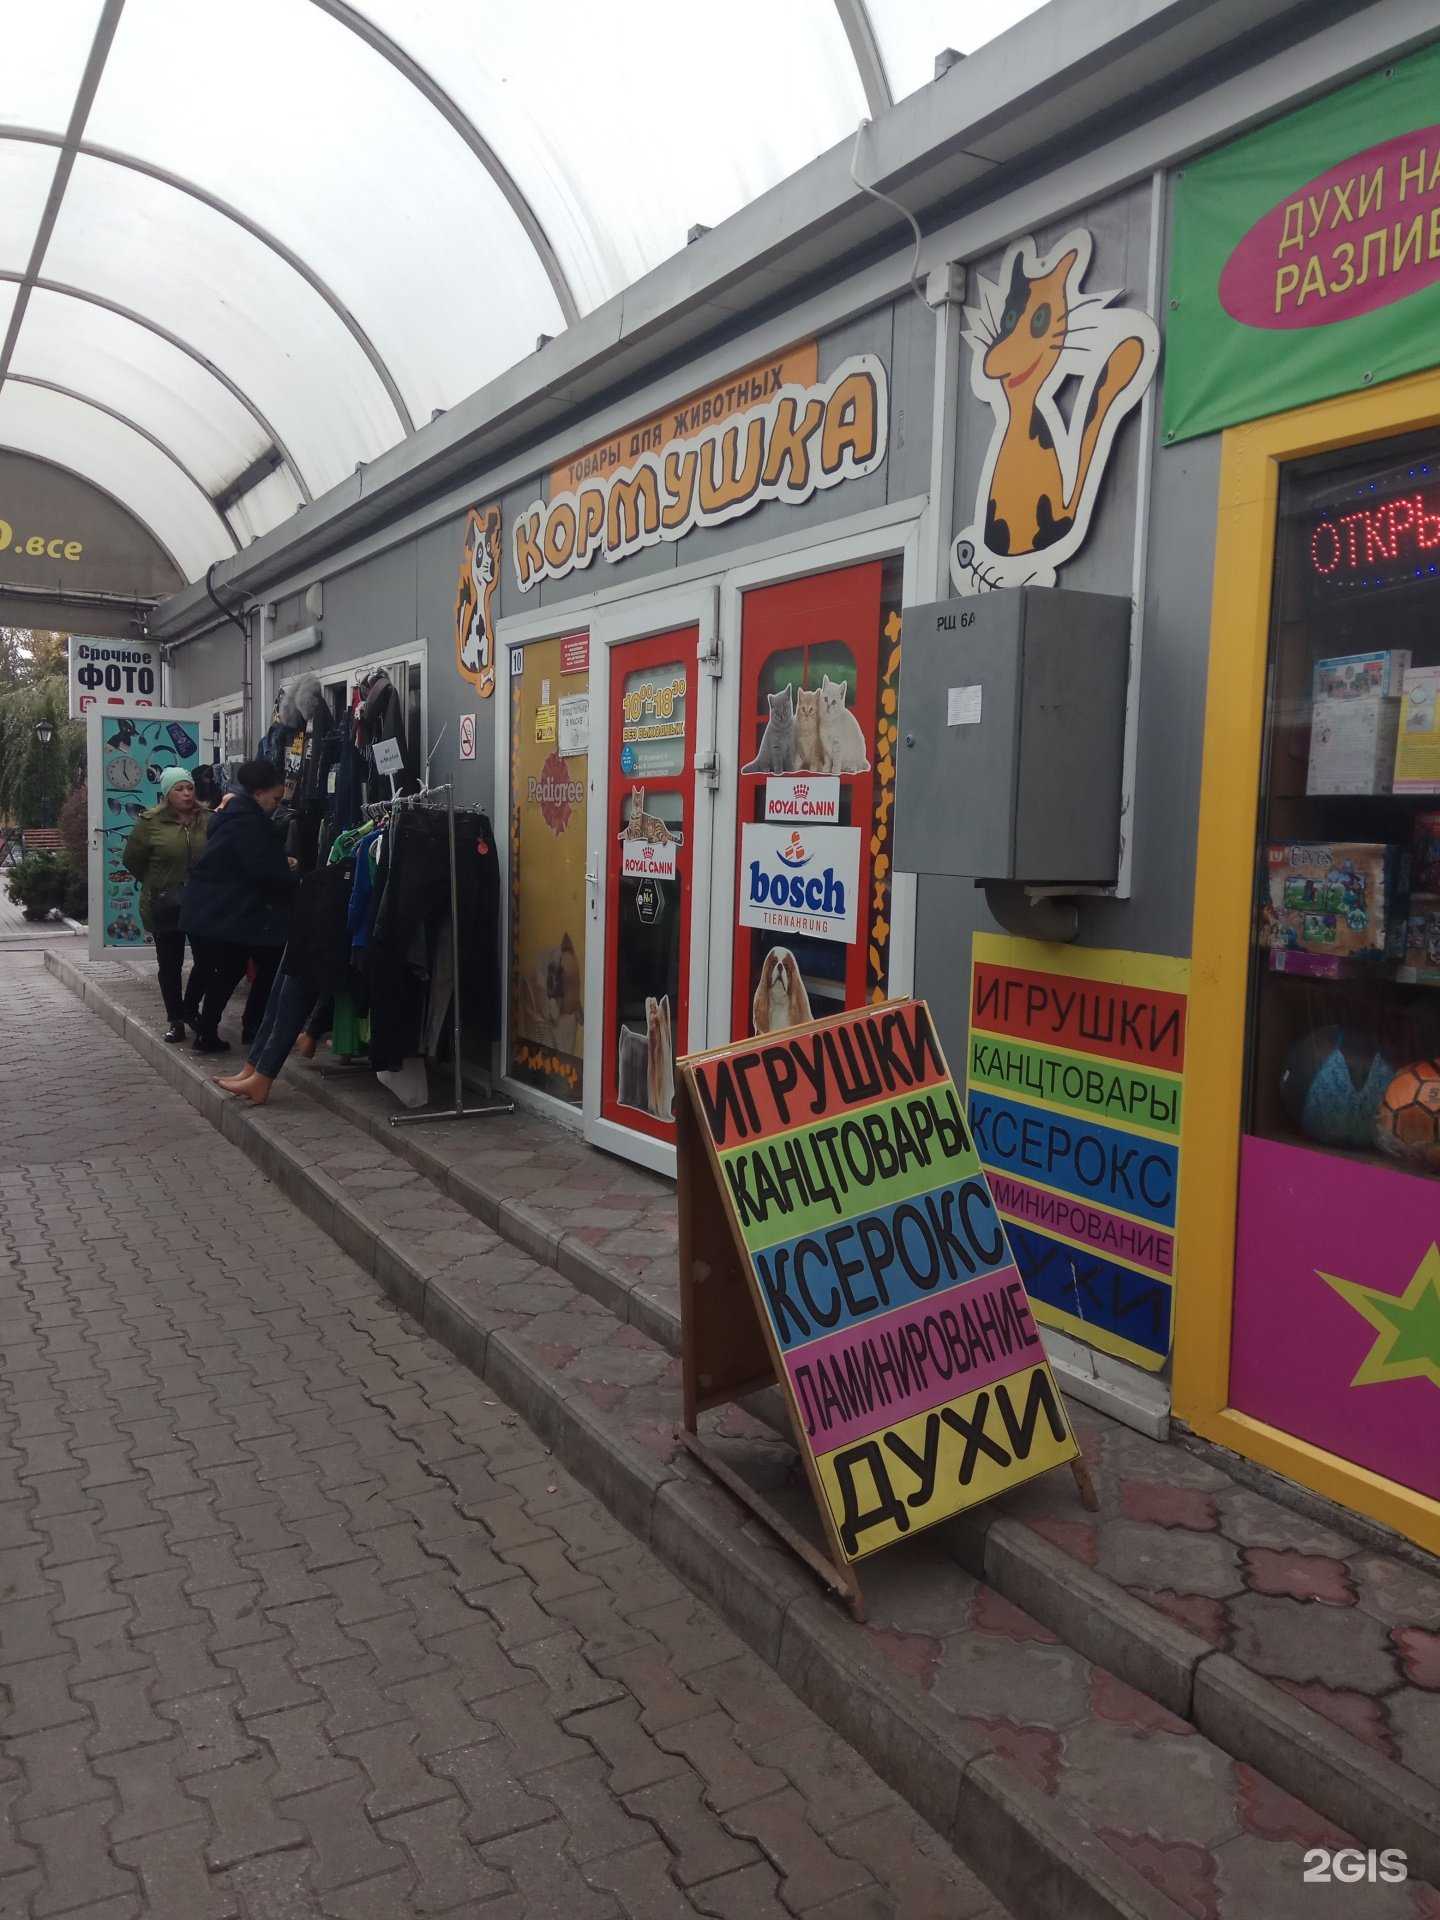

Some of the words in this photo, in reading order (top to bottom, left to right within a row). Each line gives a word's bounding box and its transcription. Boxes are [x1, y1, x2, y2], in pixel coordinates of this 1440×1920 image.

[1278, 166, 1384, 259] ДУХИ
[568, 442, 621, 485] ТОВАРЫ
[630, 423, 663, 458] ДЛЯ
[673, 364, 784, 438] ЖИВОТНЫХ
[514, 370, 879, 585] КОРМУШКА
[78, 663, 154, 694] ФОТО
[79, 645, 152, 665] Срочное
[513, 651, 522, 672] 10
[623, 727, 638, 742] БЕЗ
[528, 776, 584, 807] Pedigree
[768, 801, 799, 815] ROYAL
[802, 801, 835, 816] CANIN
[625, 859, 648, 872] ROYAL
[648, 860, 672, 874] CANIN
[750, 861, 846, 914] bosch
[763, 913, 828, 933] TIERNAHRUNG
[976, 975, 1181, 1057] ИГРУШКИ
[698, 1005, 946, 1145] ИГРУШКИ
[973, 1043, 1177, 1124] КАНЦТОВАРЫ
[724, 1089, 970, 1227] КАНЦТОВАРЫ
[970, 1105, 1172, 1209] КСЕРОКС
[758, 1181, 1004, 1344] КСЕРОКС
[984, 1175, 1171, 1267] МИНИРОВАНИЕ
[1016, 1232, 1162, 1336] УХИ
[794, 1283, 1038, 1438] ЛАМИНИРОВАНИЕ
[833, 1369, 1067, 1556] ДУХИ
